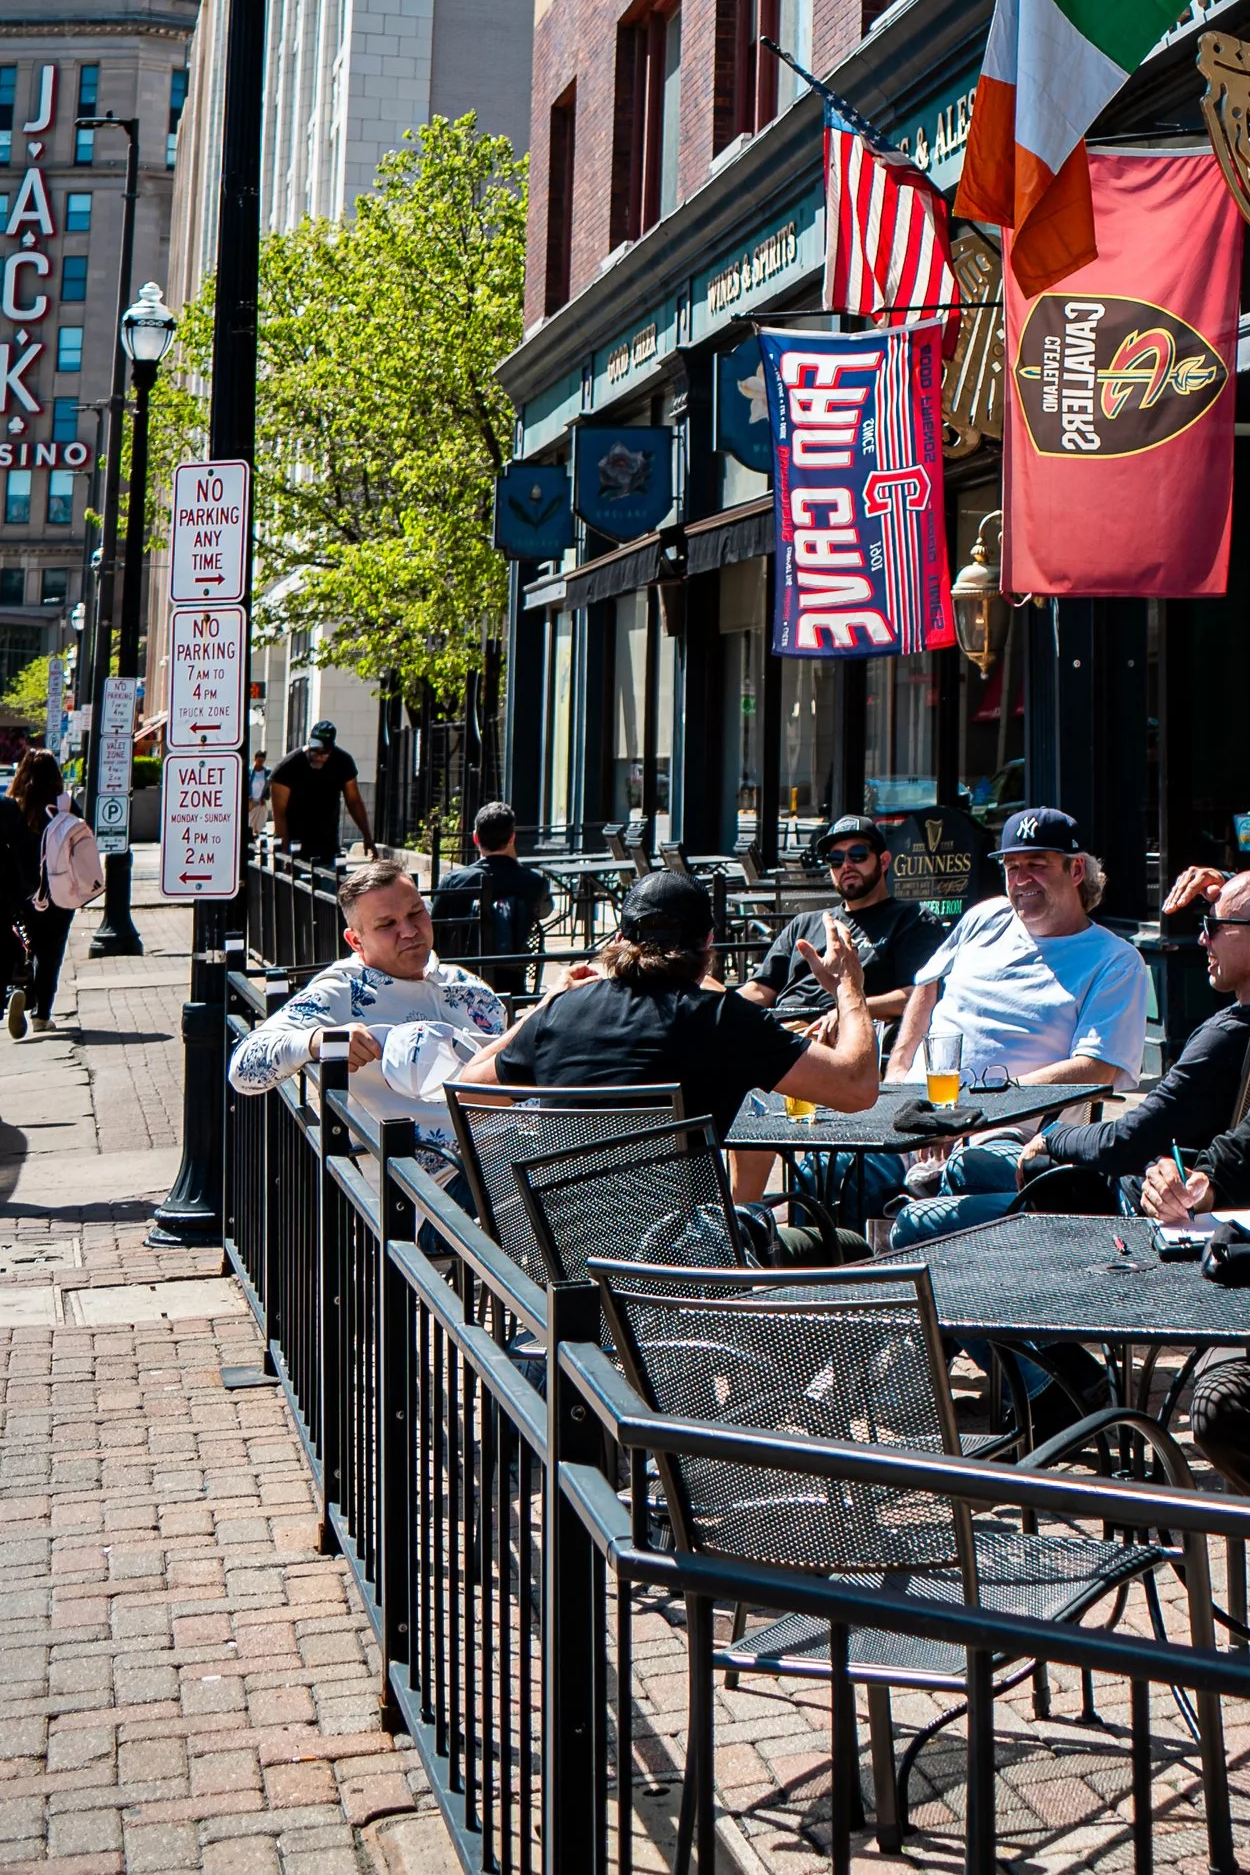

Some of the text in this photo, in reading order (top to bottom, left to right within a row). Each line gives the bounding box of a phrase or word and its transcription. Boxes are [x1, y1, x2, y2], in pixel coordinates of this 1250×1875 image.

[915, 127, 929, 170] &
[0, 64, 57, 414] JACK
[707, 221, 796, 314] WINES & SPIRITS
[196, 478, 223, 502] NO
[179, 506, 239, 526] PARKING
[194, 530, 222, 547] ANY
[192, 553, 223, 571] TIME
[193, 618, 220, 638] NO
[177, 642, 235, 661] PARKING
[187, 665, 225, 681] 7 AM TO
[193, 684, 217, 700] 4 PM
[179, 706, 230, 718] TRUCK ZONE
[106, 742, 126, 750] VALET
[106, 751, 125, 759] ZONE
[178, 768, 226, 786] VALET
[179, 790, 223, 808] ZONE
[108, 805, 118, 820] P
[171, 814, 199, 823] MONDAY
[204, 813, 232, 823] SUNDAY
[182, 827, 221, 844] 4 PM TO
[185, 848, 215, 864] 2 AM
[894, 853, 972, 876] GUINNESS
[941, 899, 963, 915] FROM
